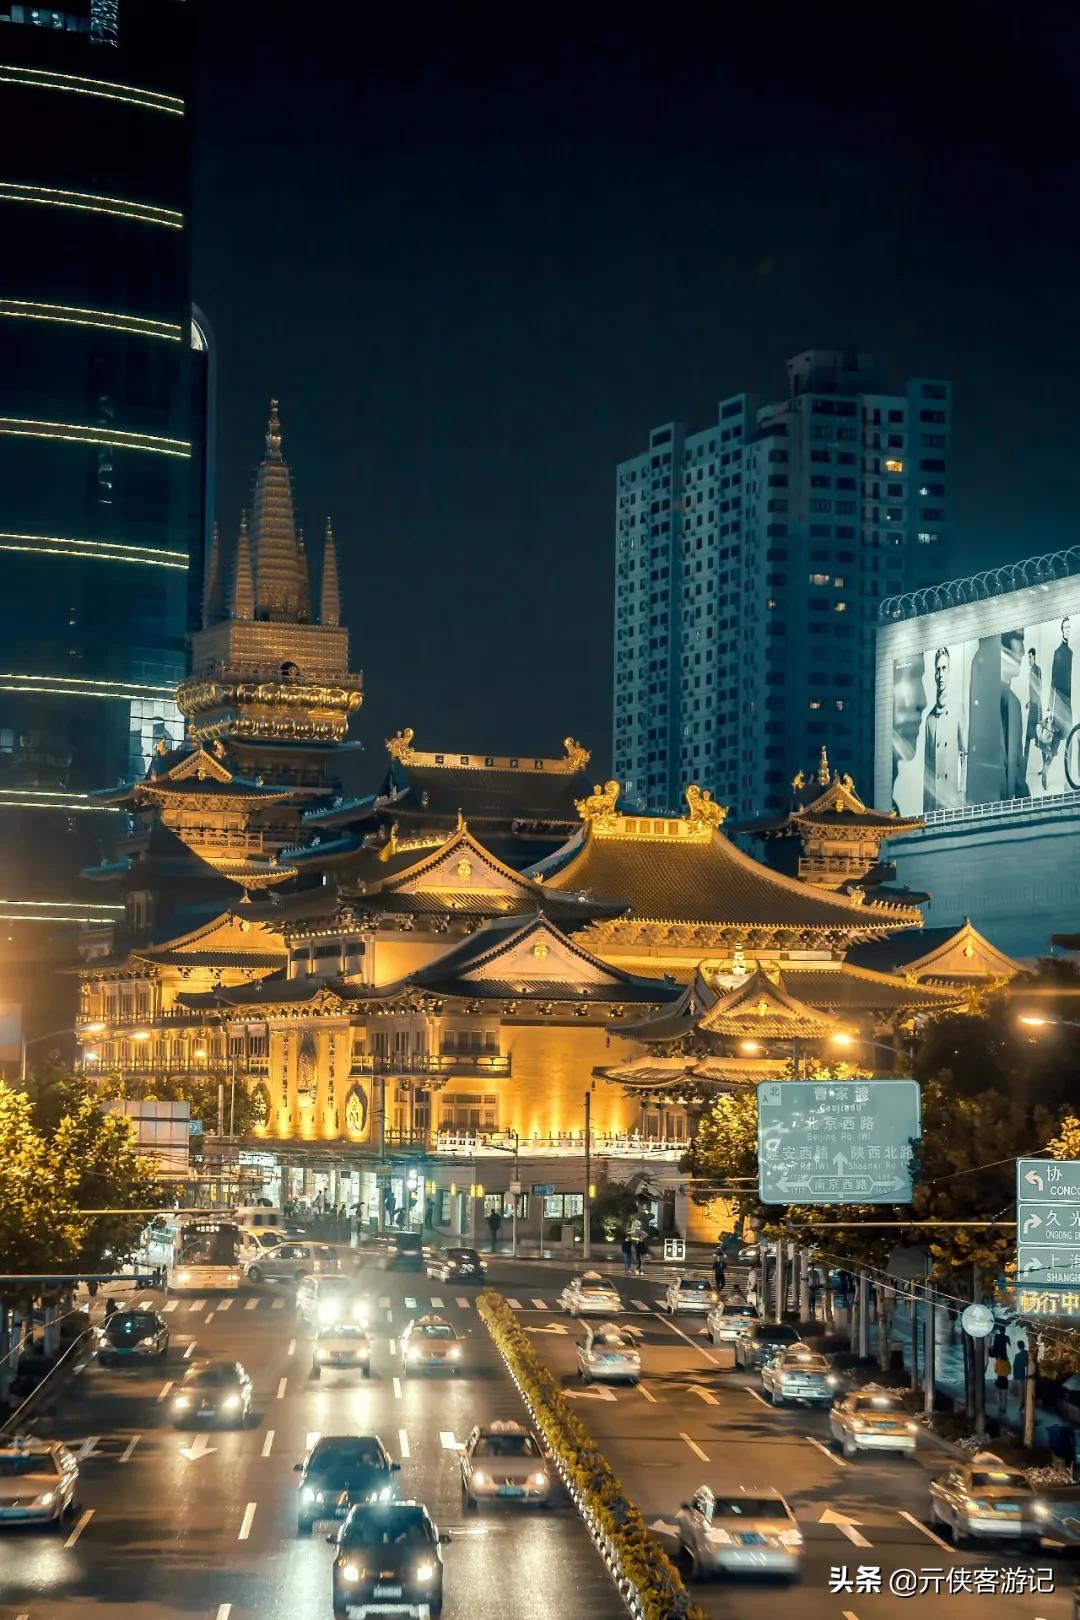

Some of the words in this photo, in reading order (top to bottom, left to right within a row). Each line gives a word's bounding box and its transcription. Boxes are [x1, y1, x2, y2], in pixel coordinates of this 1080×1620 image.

[769, 1086, 780, 1096] 北
[814, 1086, 870, 1102] 曹家渡
[805, 1116, 875, 1131] 北京西路
[807, 1133, 836, 1143] Beijing
[767, 1146, 829, 1161] 延安西路
[850, 1145, 913, 1161] 陕西北路
[1045, 1165, 1062, 1182] 协
[814, 1179, 869, 1191] 南京西路
